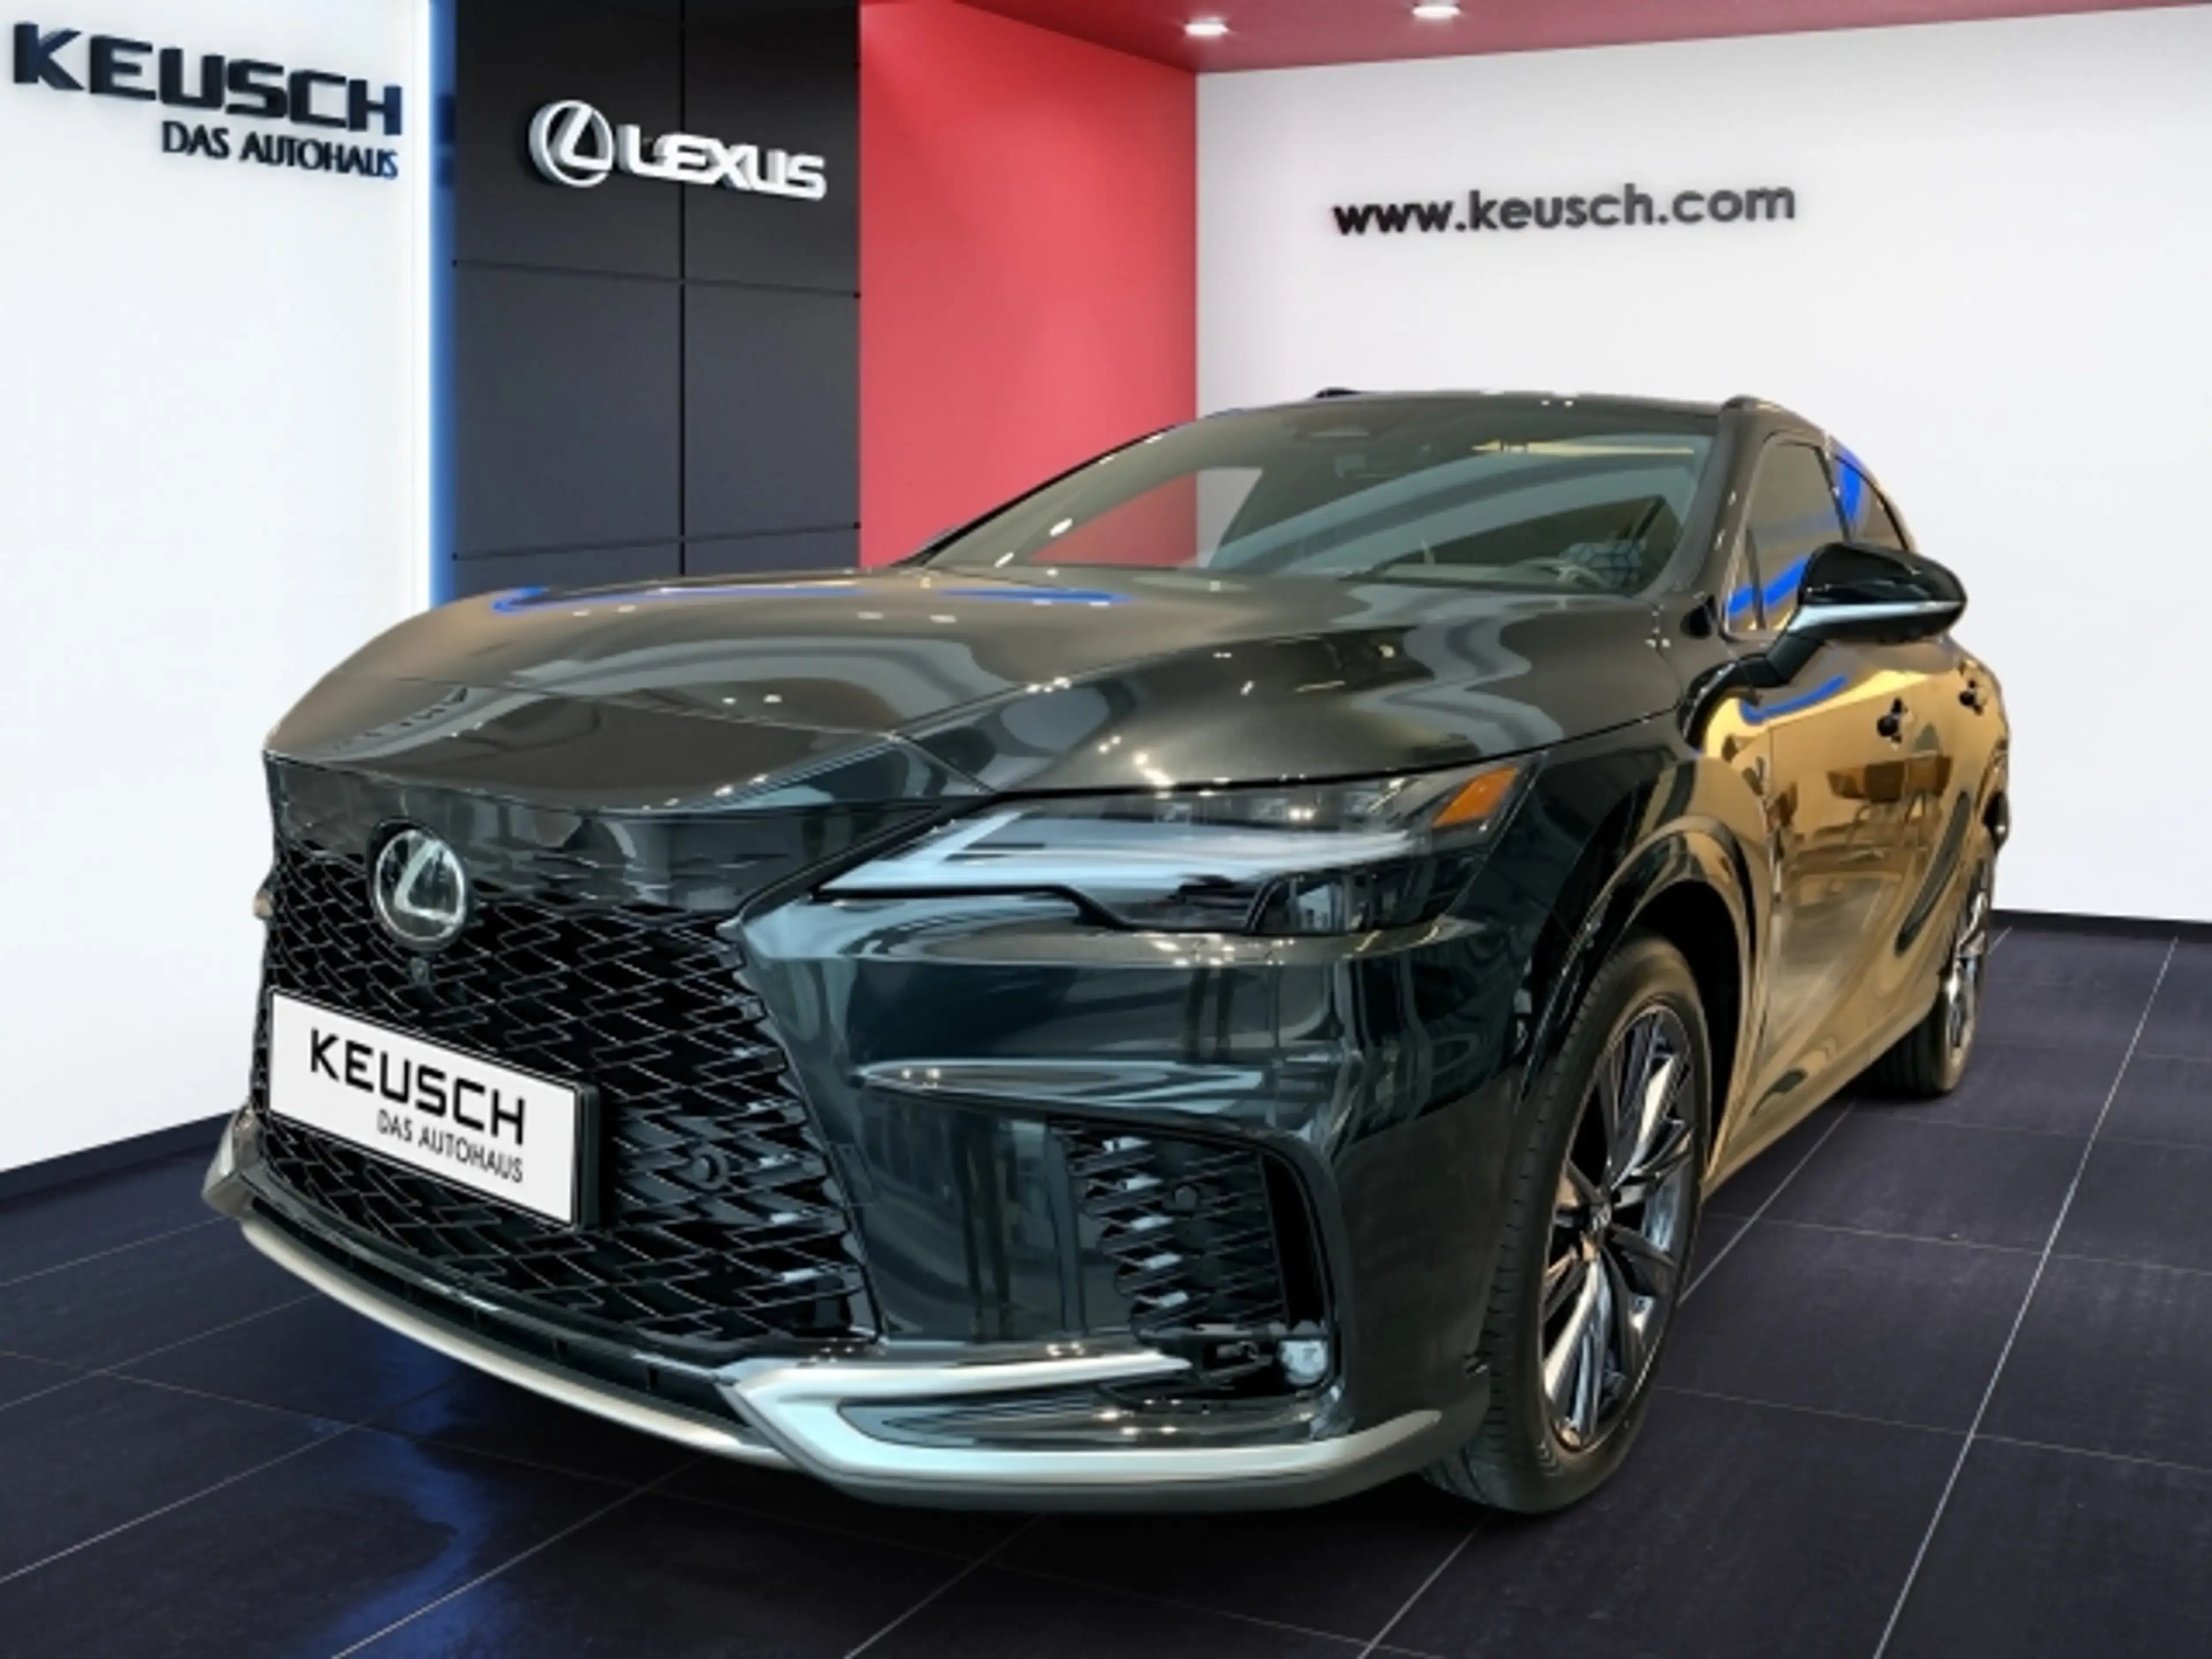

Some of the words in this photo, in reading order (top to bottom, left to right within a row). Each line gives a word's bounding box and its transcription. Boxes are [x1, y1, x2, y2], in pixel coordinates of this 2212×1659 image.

[13, 22, 402, 136] KEUSCH
[161, 120, 230, 159] DAS
[239, 131, 399, 179] AUTOHAUS
[616, 123, 827, 201] LEXUS
[1331, 183, 1796, 235] www.keusch.com
[310, 1028, 525, 1146] KEUSCH
[377, 1108, 412, 1142] DAS
[418, 1126, 523, 1184] AUTOHAUS
